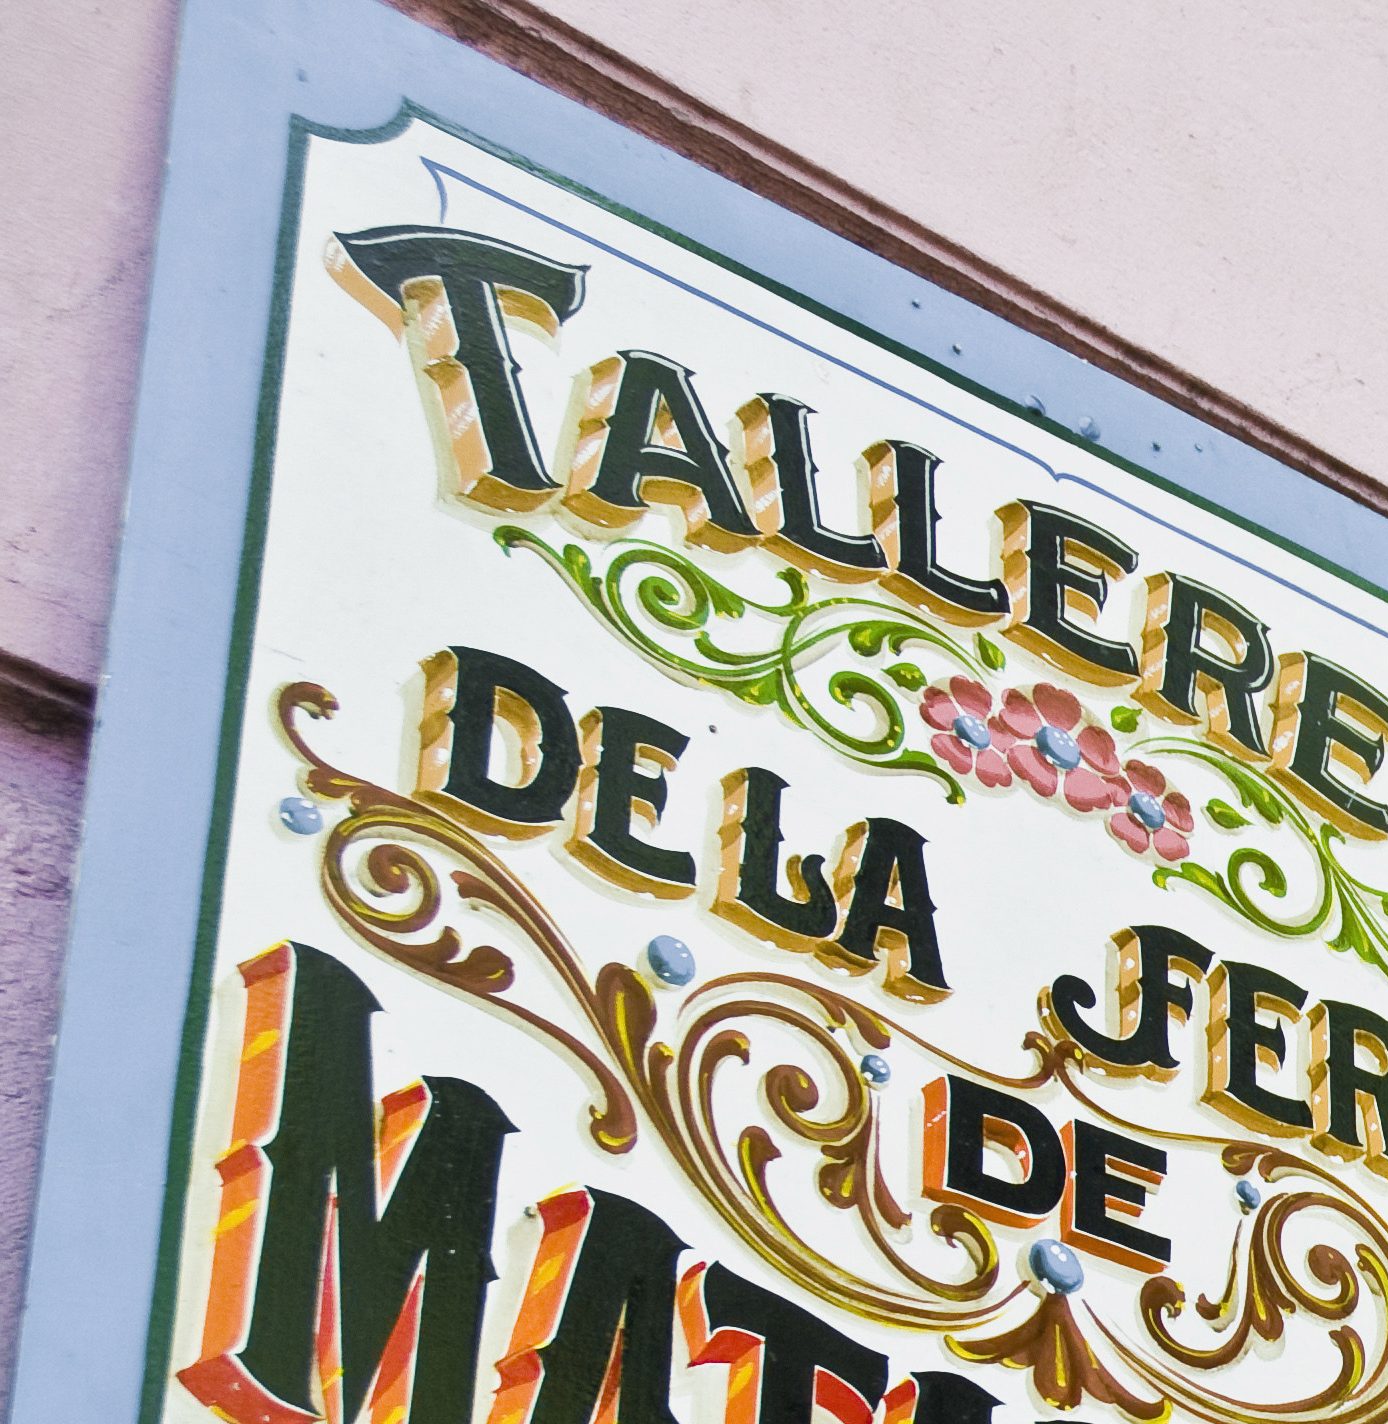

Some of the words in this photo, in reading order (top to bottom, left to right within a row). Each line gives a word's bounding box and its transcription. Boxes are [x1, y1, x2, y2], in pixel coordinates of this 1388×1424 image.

[414, 645, 698, 900] DE
[709, 765, 953, 1002] LA
[923, 1076, 1171, 1275] DE
